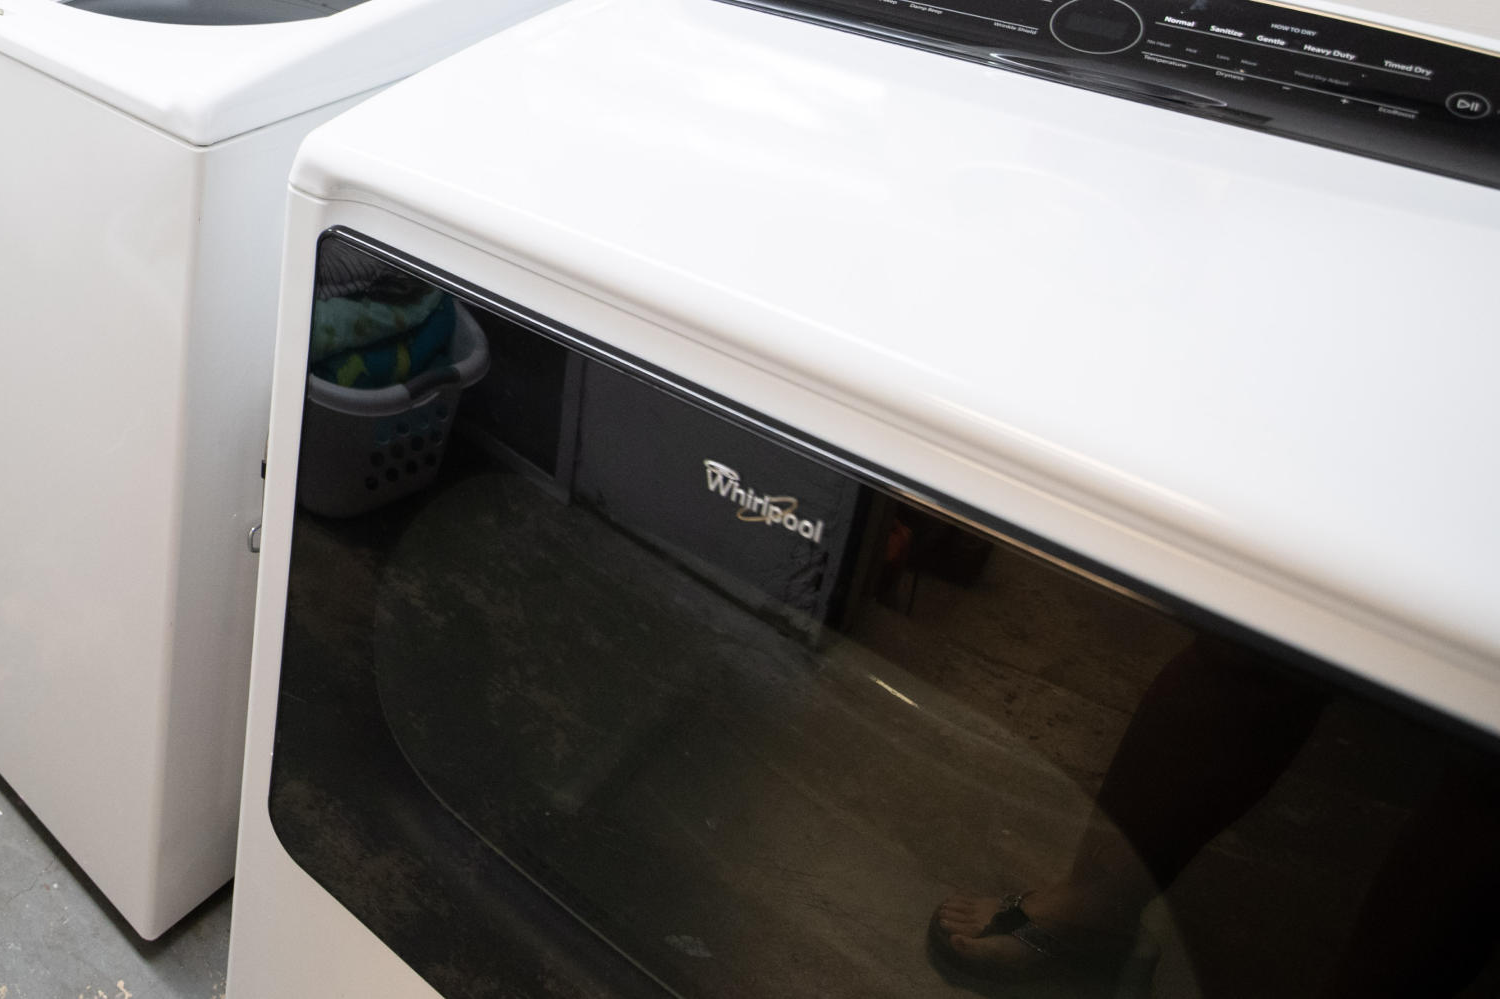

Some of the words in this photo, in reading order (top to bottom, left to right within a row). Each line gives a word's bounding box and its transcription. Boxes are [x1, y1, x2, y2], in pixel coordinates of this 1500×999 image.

[1164, 16, 1195, 27] Normal
[1209, 25, 1244, 37] Sanitize
[1271, 23, 1290, 32] HOW
[1290, 26, 1300, 34] TO
[1301, 28, 1317, 37] DRY
[1256, 34, 1286, 46] Gentle
[1303, 44, 1331, 57] Heavy
[1333, 49, 1356, 61] Duty
[1143, 54, 1188, 68] Temperature
[1384, 60, 1413, 72] Timed
[1413, 65, 1433, 77] Dry
[704, 462, 824, 543] Whirlpool
